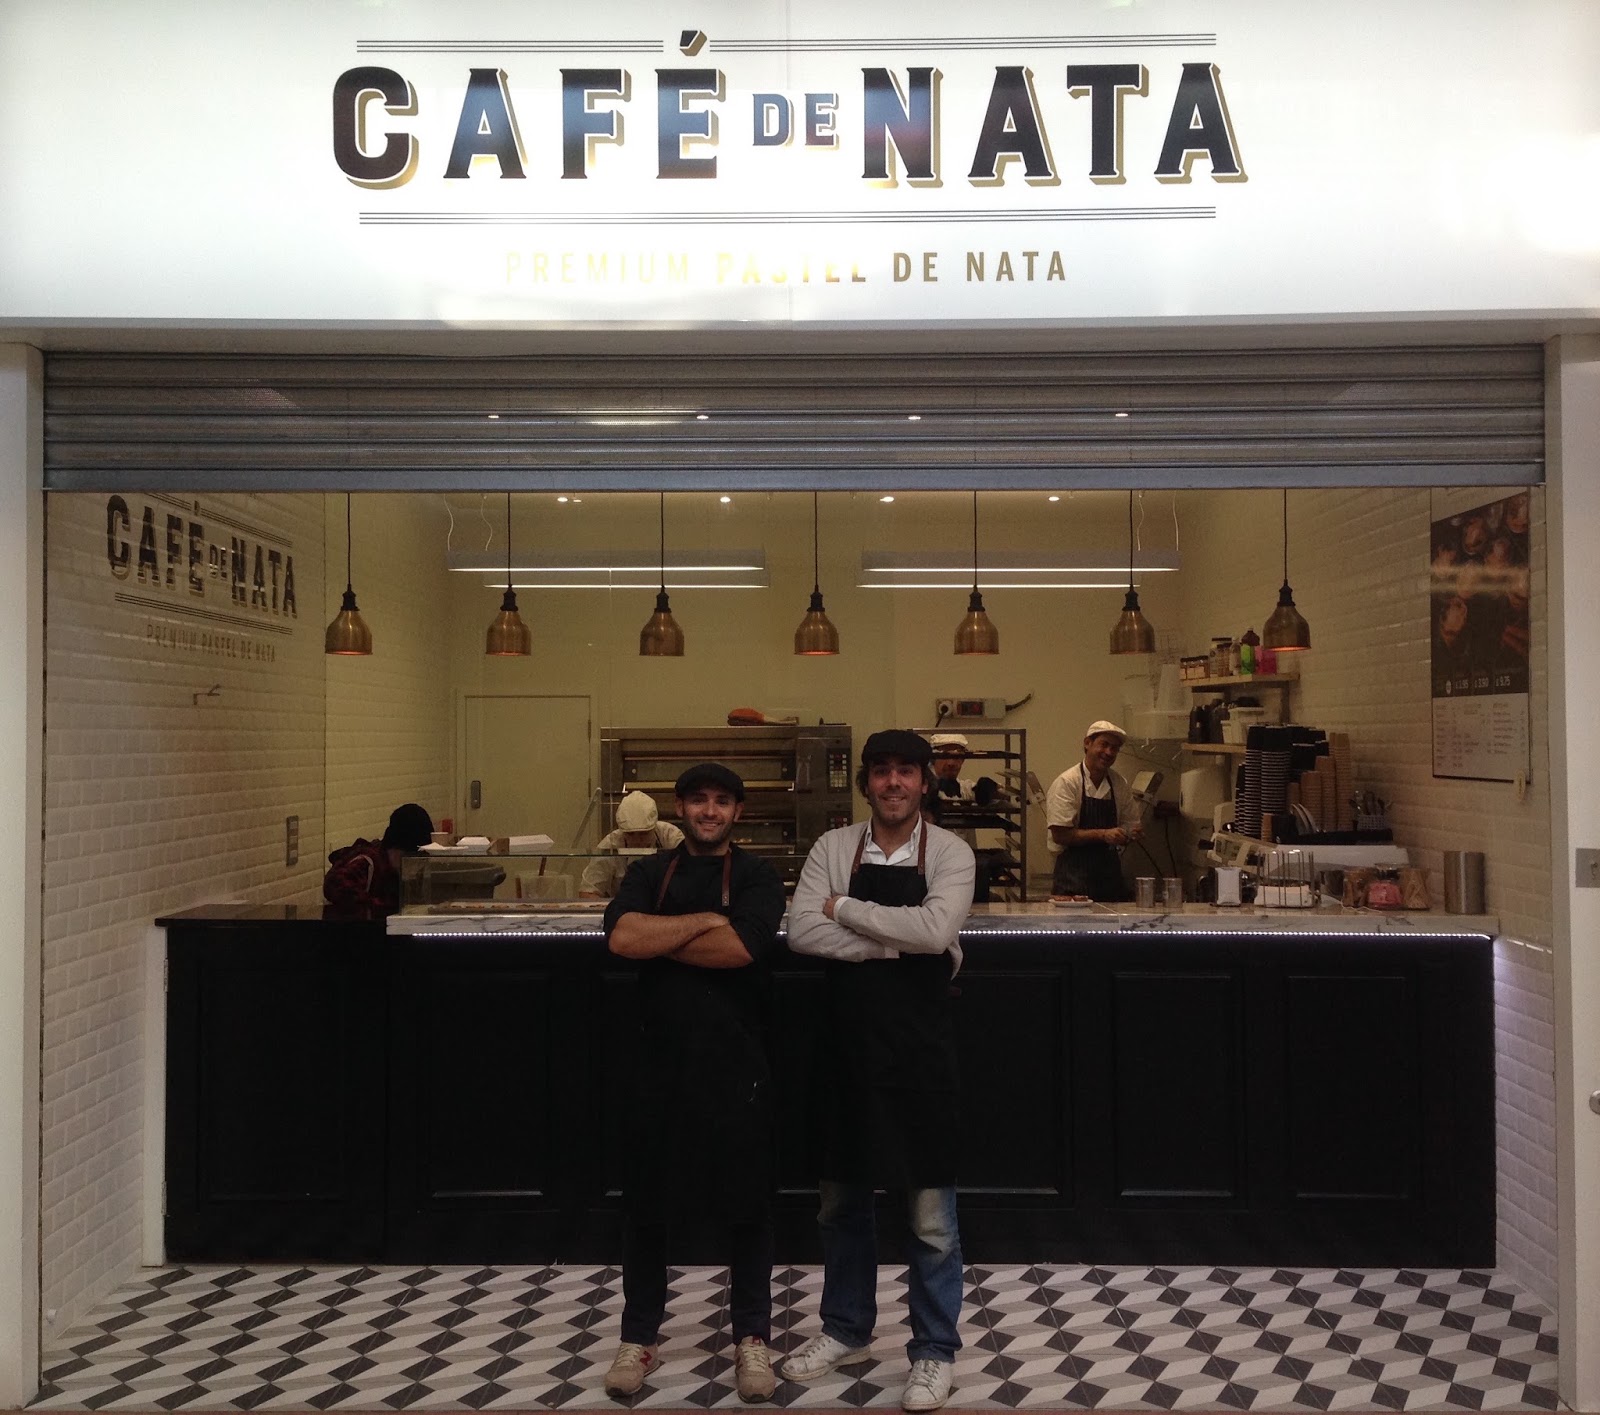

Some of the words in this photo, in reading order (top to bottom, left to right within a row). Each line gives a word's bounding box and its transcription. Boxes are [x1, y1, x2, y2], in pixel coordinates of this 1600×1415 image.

[333, 30, 726, 190] CAFÉ
[752, 93, 839, 150] DE
[861, 62, 1248, 188] NATA
[505, 251, 690, 284] PREMIUM
[893, 252, 938, 282] DE
[966, 250, 1066, 281] NATA
[107, 494, 205, 598] CAFÉ
[231, 535, 297, 619] NATA
